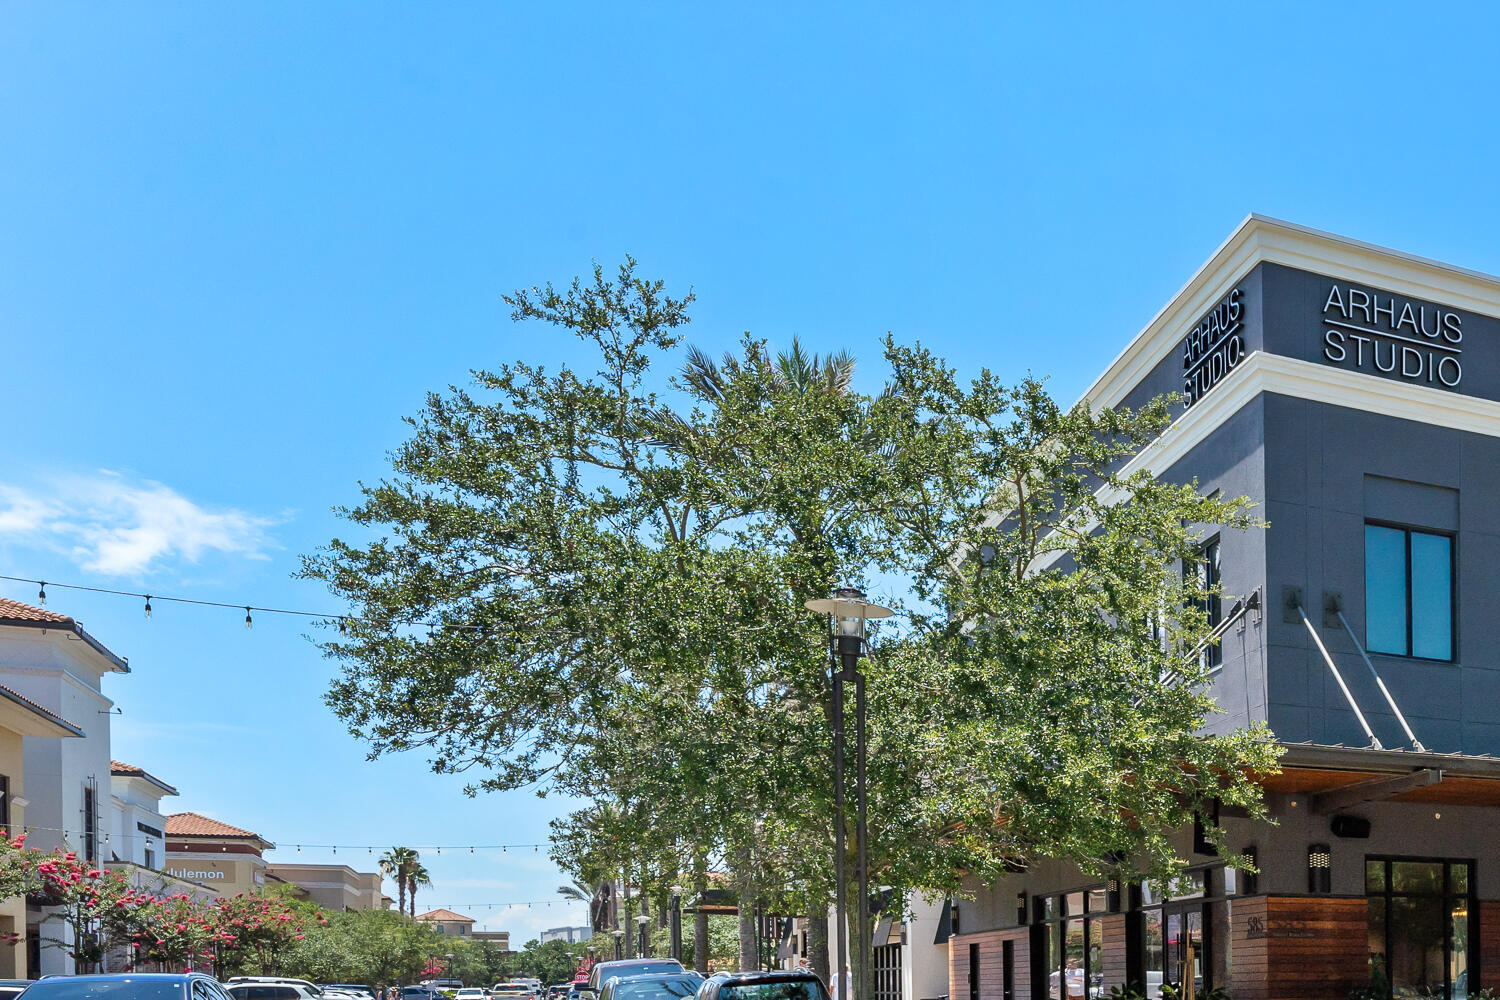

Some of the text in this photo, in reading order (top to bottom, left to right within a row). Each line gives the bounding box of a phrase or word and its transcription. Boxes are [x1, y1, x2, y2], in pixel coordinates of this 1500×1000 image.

[1183, 288, 1241, 362] ARHAUS
[1323, 285, 1463, 343] ARHAUS
[1183, 335, 1240, 409] STUDIO
[1325, 329, 1462, 387] STUDIO
[167, 867, 225, 879] lulemon
